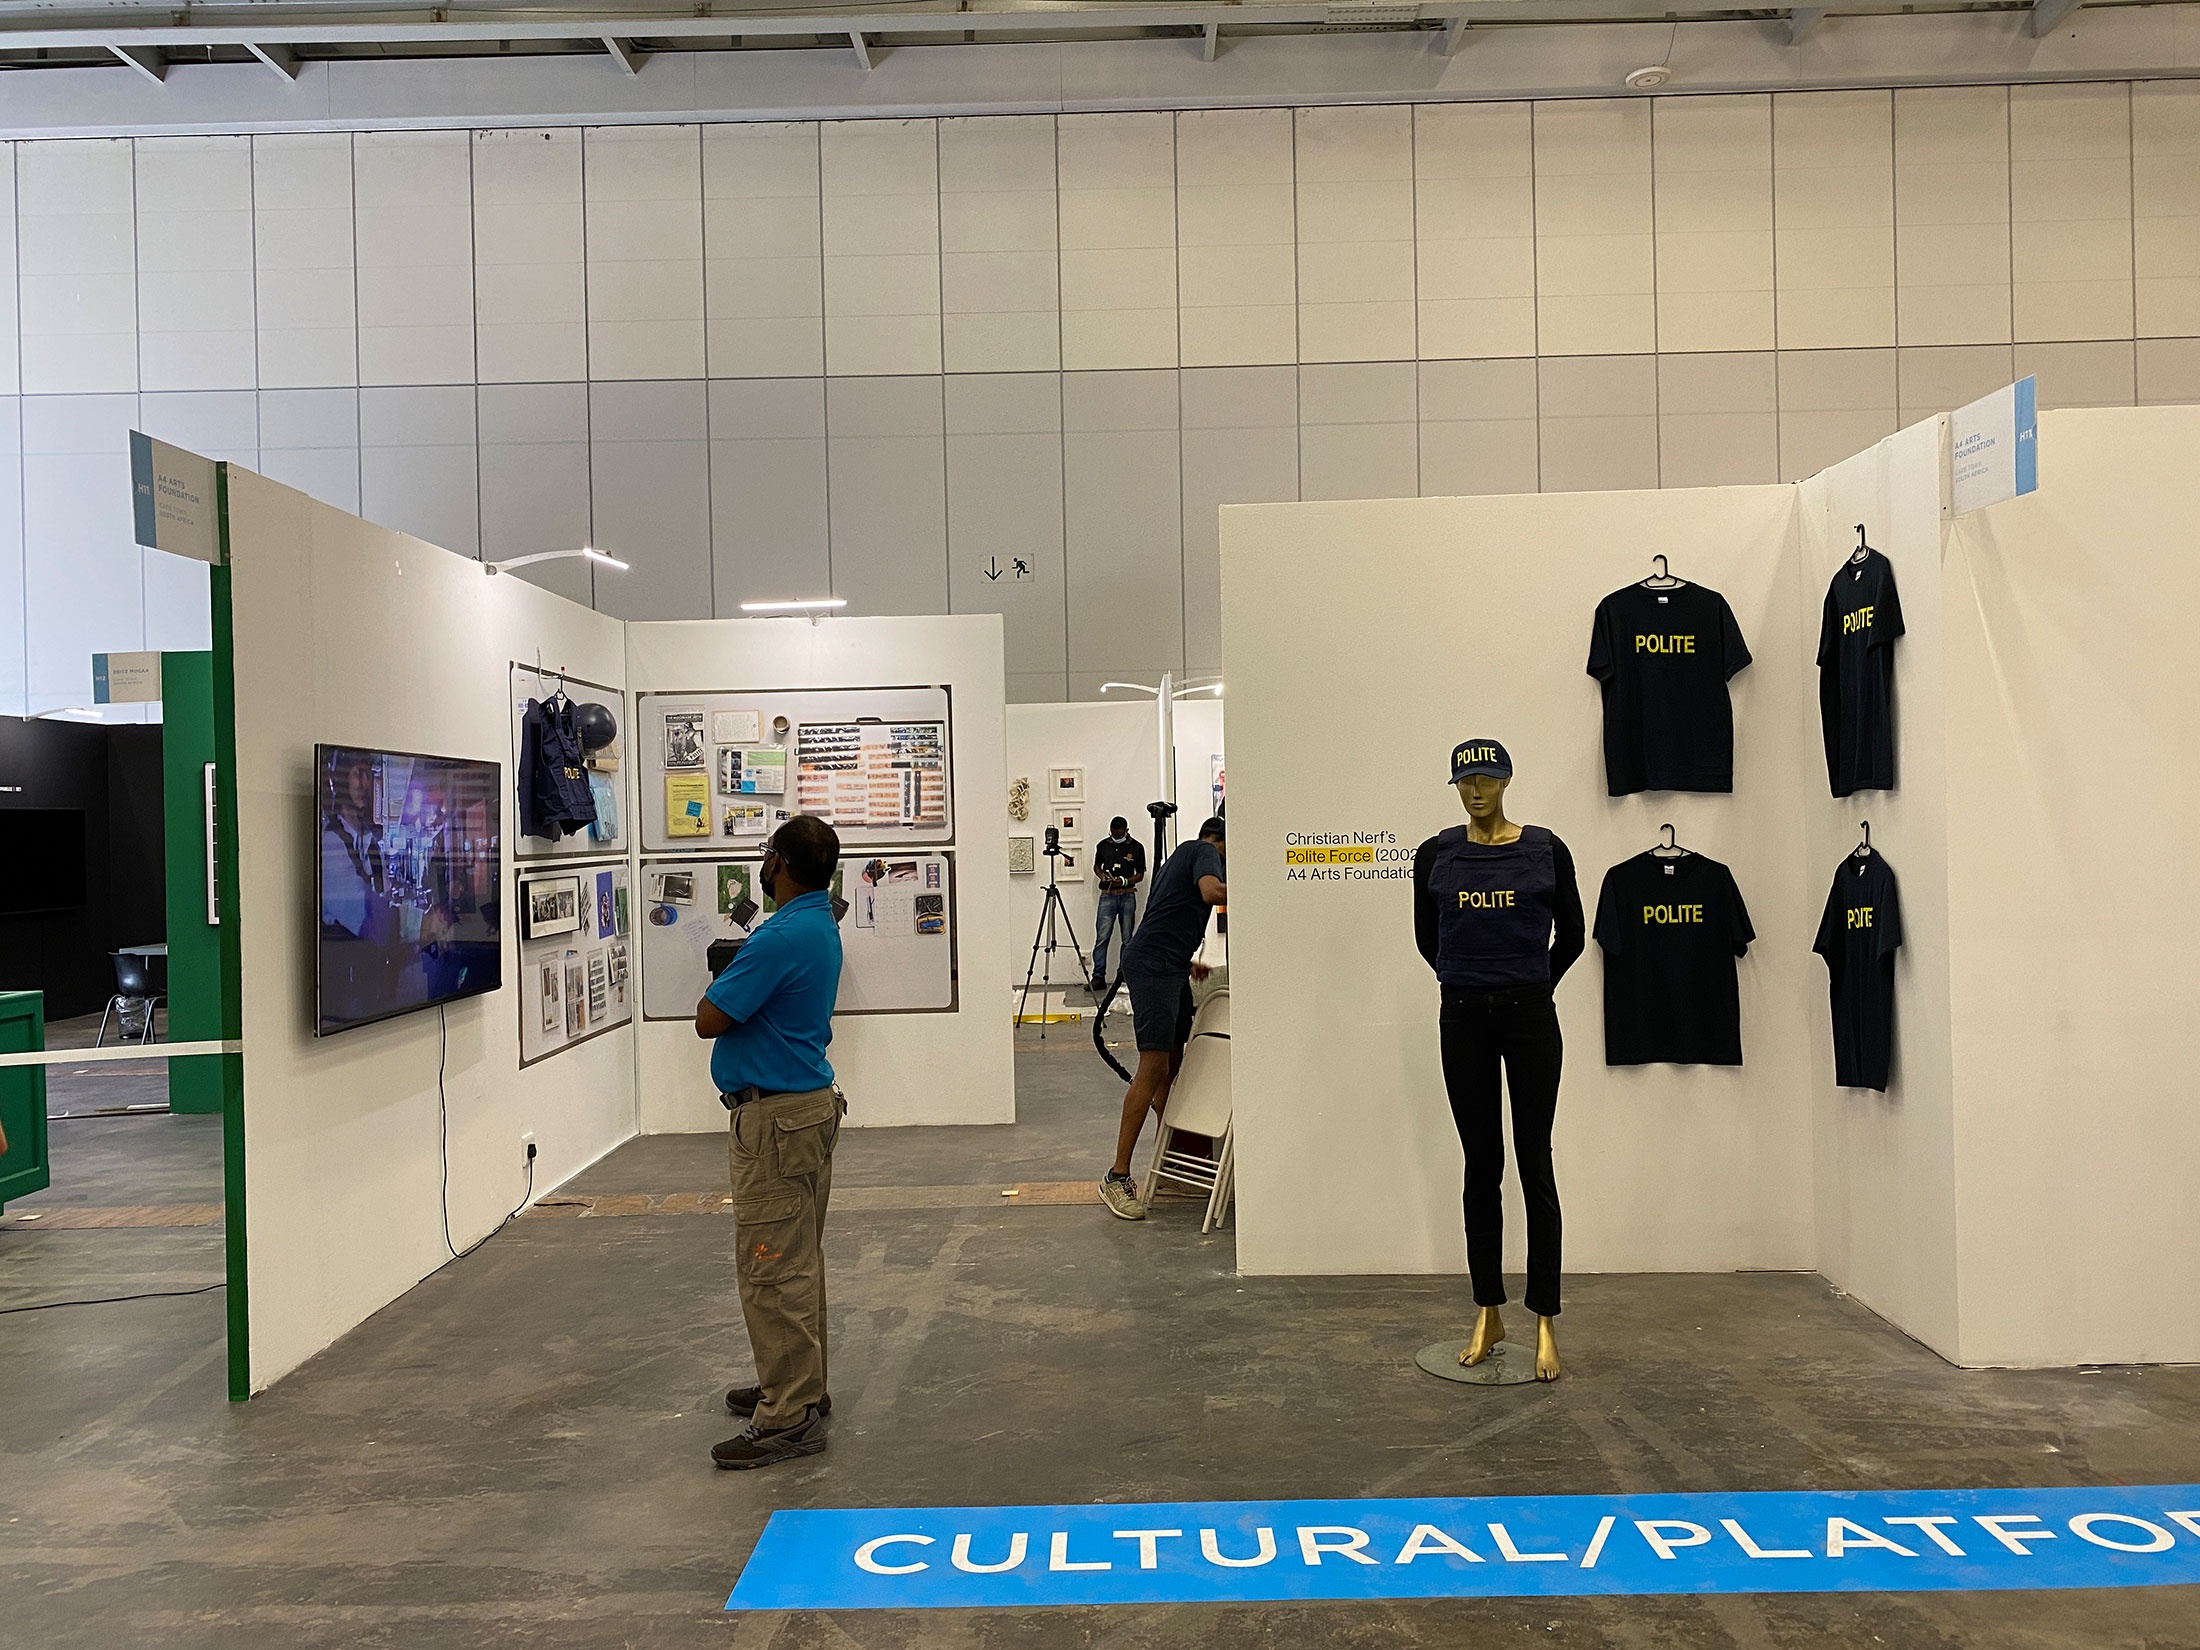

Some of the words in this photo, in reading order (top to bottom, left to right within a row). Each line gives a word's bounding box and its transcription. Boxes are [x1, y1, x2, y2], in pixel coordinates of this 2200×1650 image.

[1955, 441, 1963, 450] A4
[1964, 433, 1981, 446] ARTS
[2020, 428, 2033, 442] H11
[1954, 437, 1996, 460] FOUNDATION
[137, 482, 150, 496] H11
[158, 473, 167, 484] A4
[168, 478, 185, 490] ARTS
[158, 484, 200, 504] FOUNDATION
[1635, 634, 1696, 654] POLITE
[1457, 747, 1497, 767] POLITE
[1286, 831, 1349, 846] Christian
[1353, 830, 1396, 844] Nerf's
[1286, 850, 1326, 863] Polite
[1329, 849, 1371, 863] Force
[1287, 868, 1307, 881] A4
[1310, 867, 1341, 881] Arts
[1344, 866, 1415, 881] Foundatio
[1458, 890, 1515, 909] POLITE
[1643, 904, 1703, 924] POLITE
[1847, 907, 1873, 930] POITE
